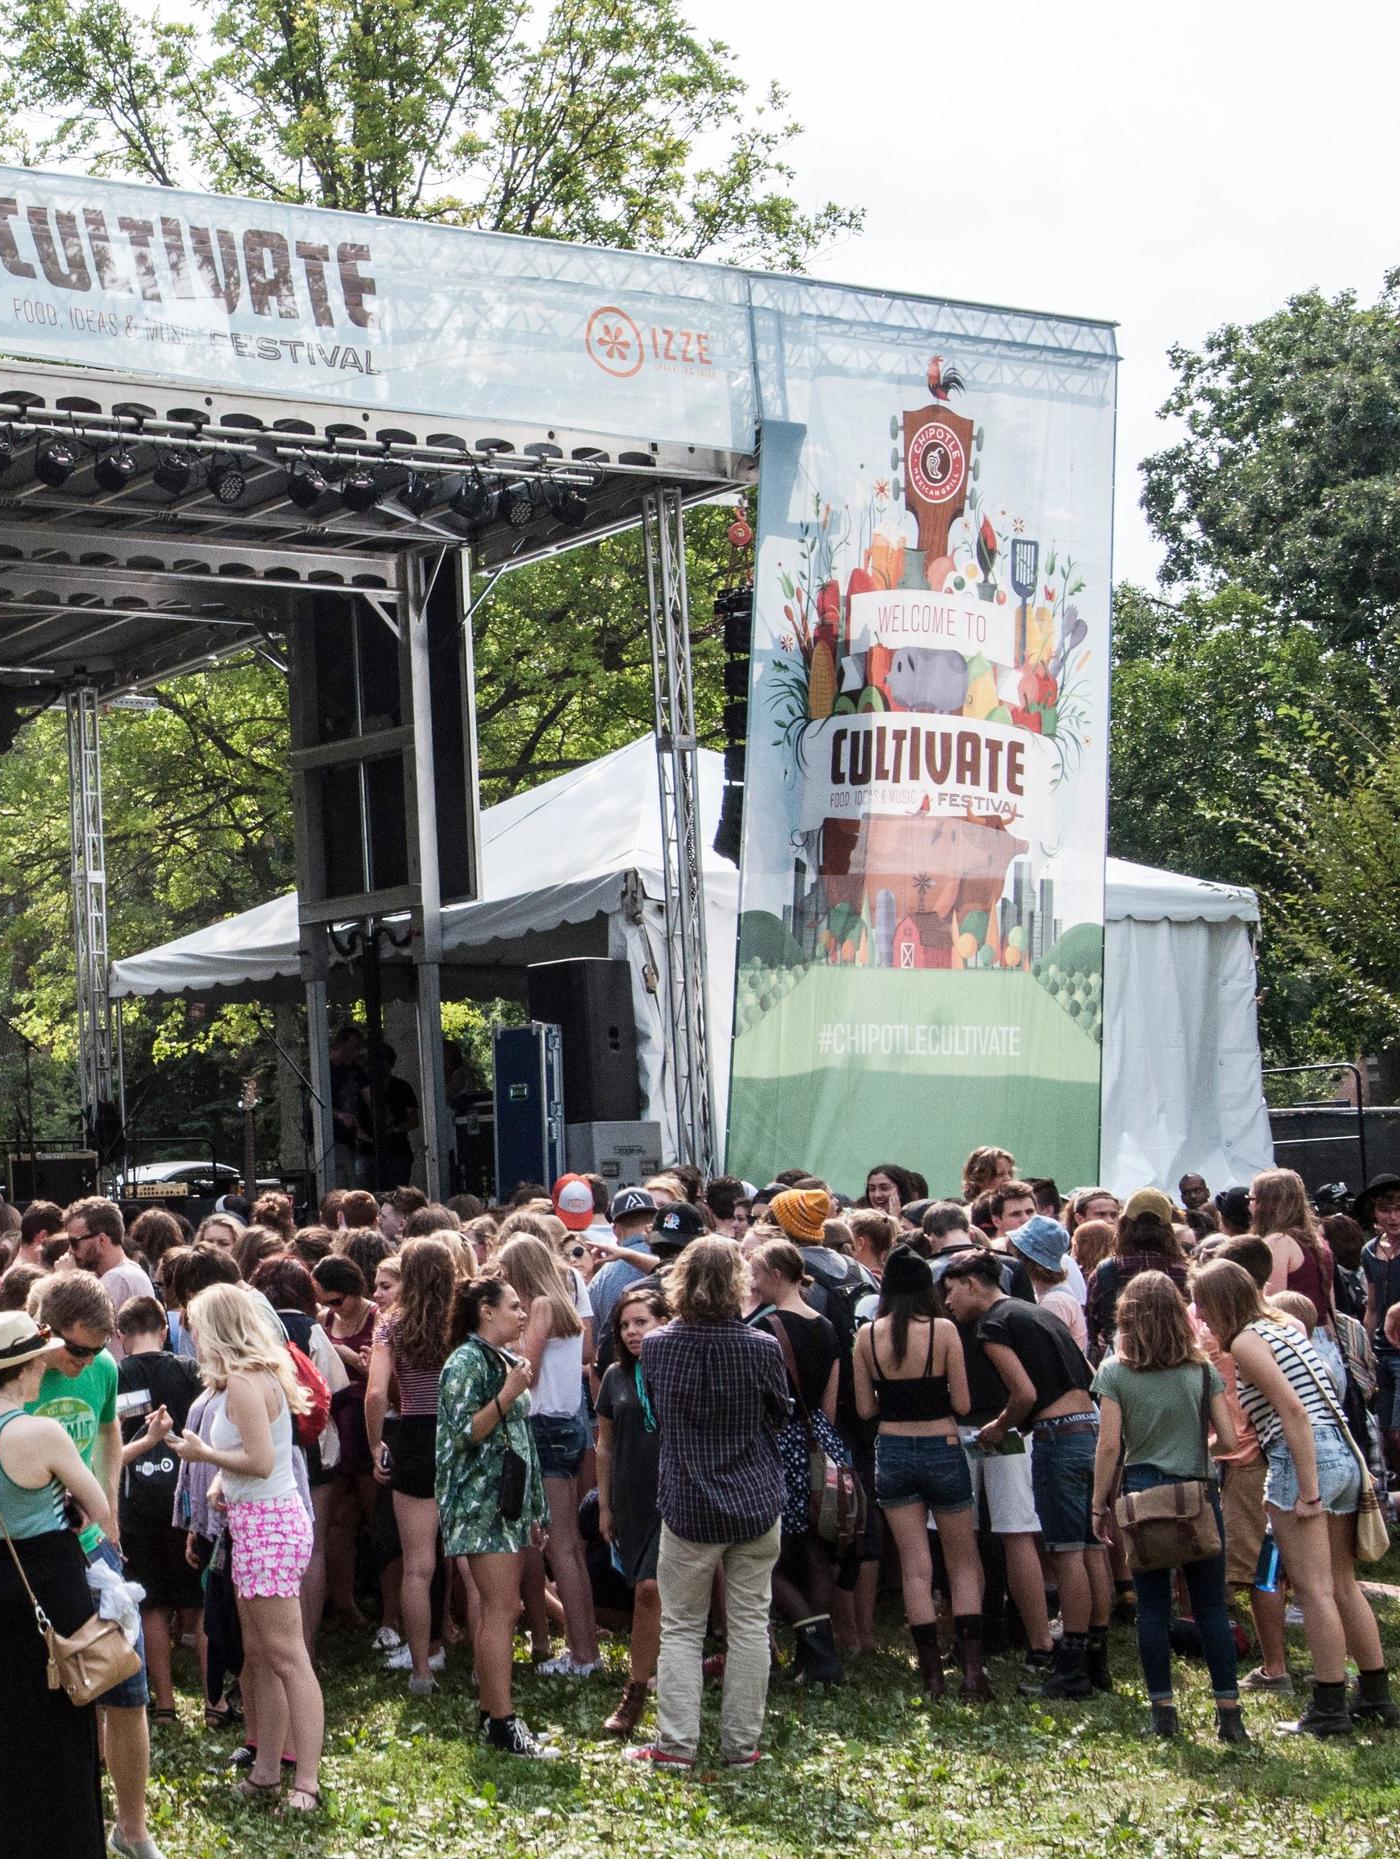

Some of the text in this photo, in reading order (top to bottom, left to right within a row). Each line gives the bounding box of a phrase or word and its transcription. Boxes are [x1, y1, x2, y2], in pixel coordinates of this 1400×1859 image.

[69, 306, 118, 337] IDEAS
[209, 331, 382, 376] FESTIVAL
[651, 327, 713, 365] IZZE
[913, 427, 961, 459] CHIPOTLE
[878, 604, 986, 642] WELCOME TO
[830, 726, 1024, 796] CULTIVATE
[938, 792, 1024, 818] FESTIVAL
[818, 1024, 1021, 1056] #CHIPOTLECULTIVATE
